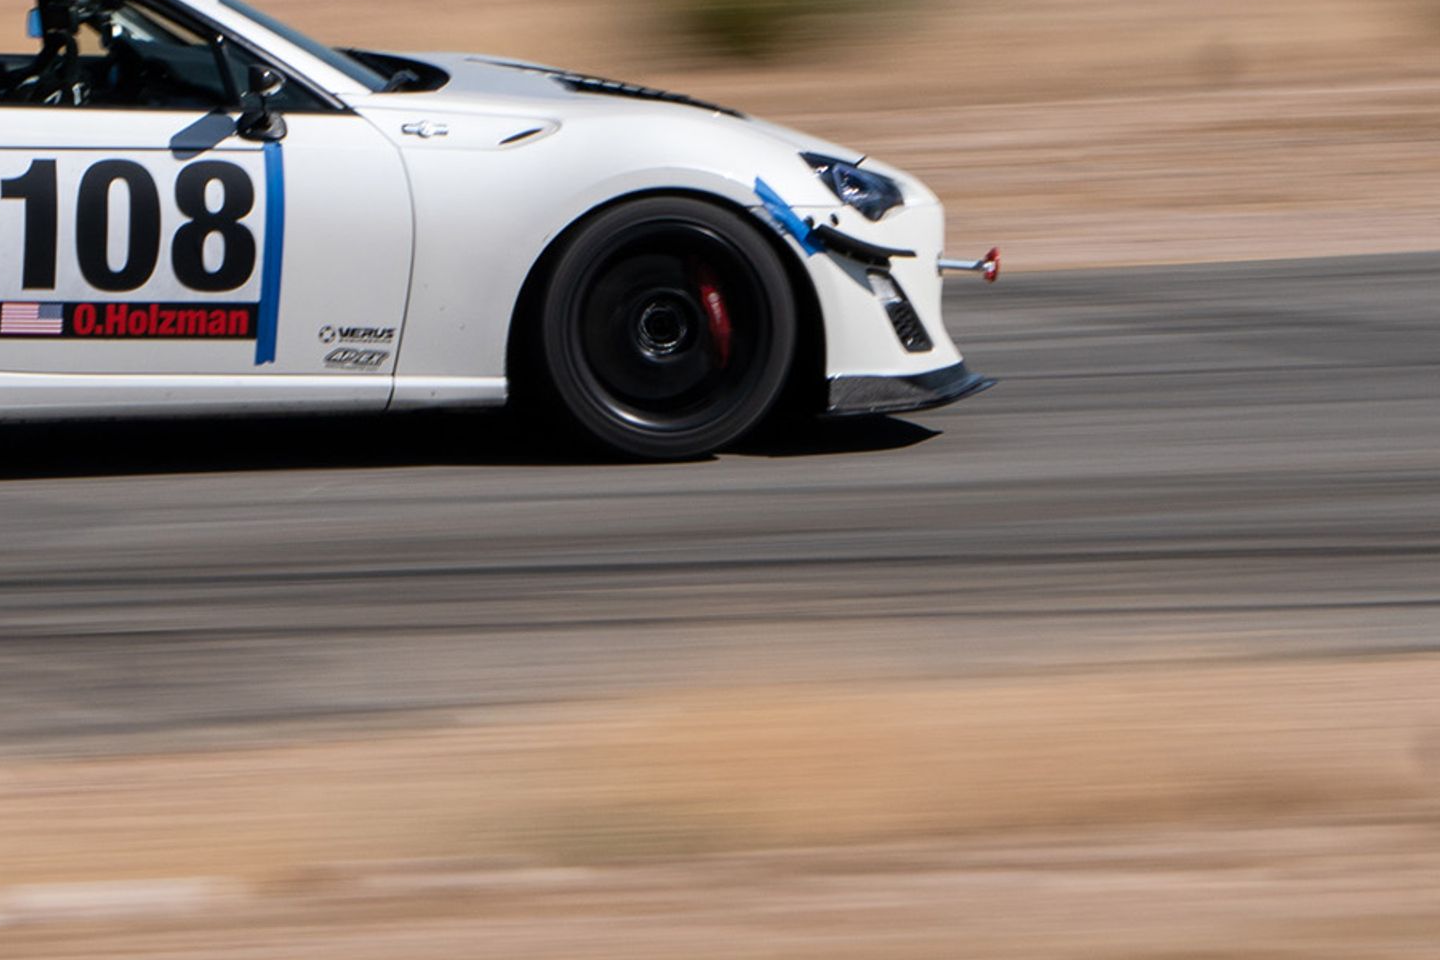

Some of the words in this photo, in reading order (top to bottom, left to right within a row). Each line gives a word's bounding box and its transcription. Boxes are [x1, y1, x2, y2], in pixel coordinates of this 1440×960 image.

[0, 159, 256, 293] 108
[73, 304, 250, 335] O.Holzman
[338, 327, 396, 338] VERUS
